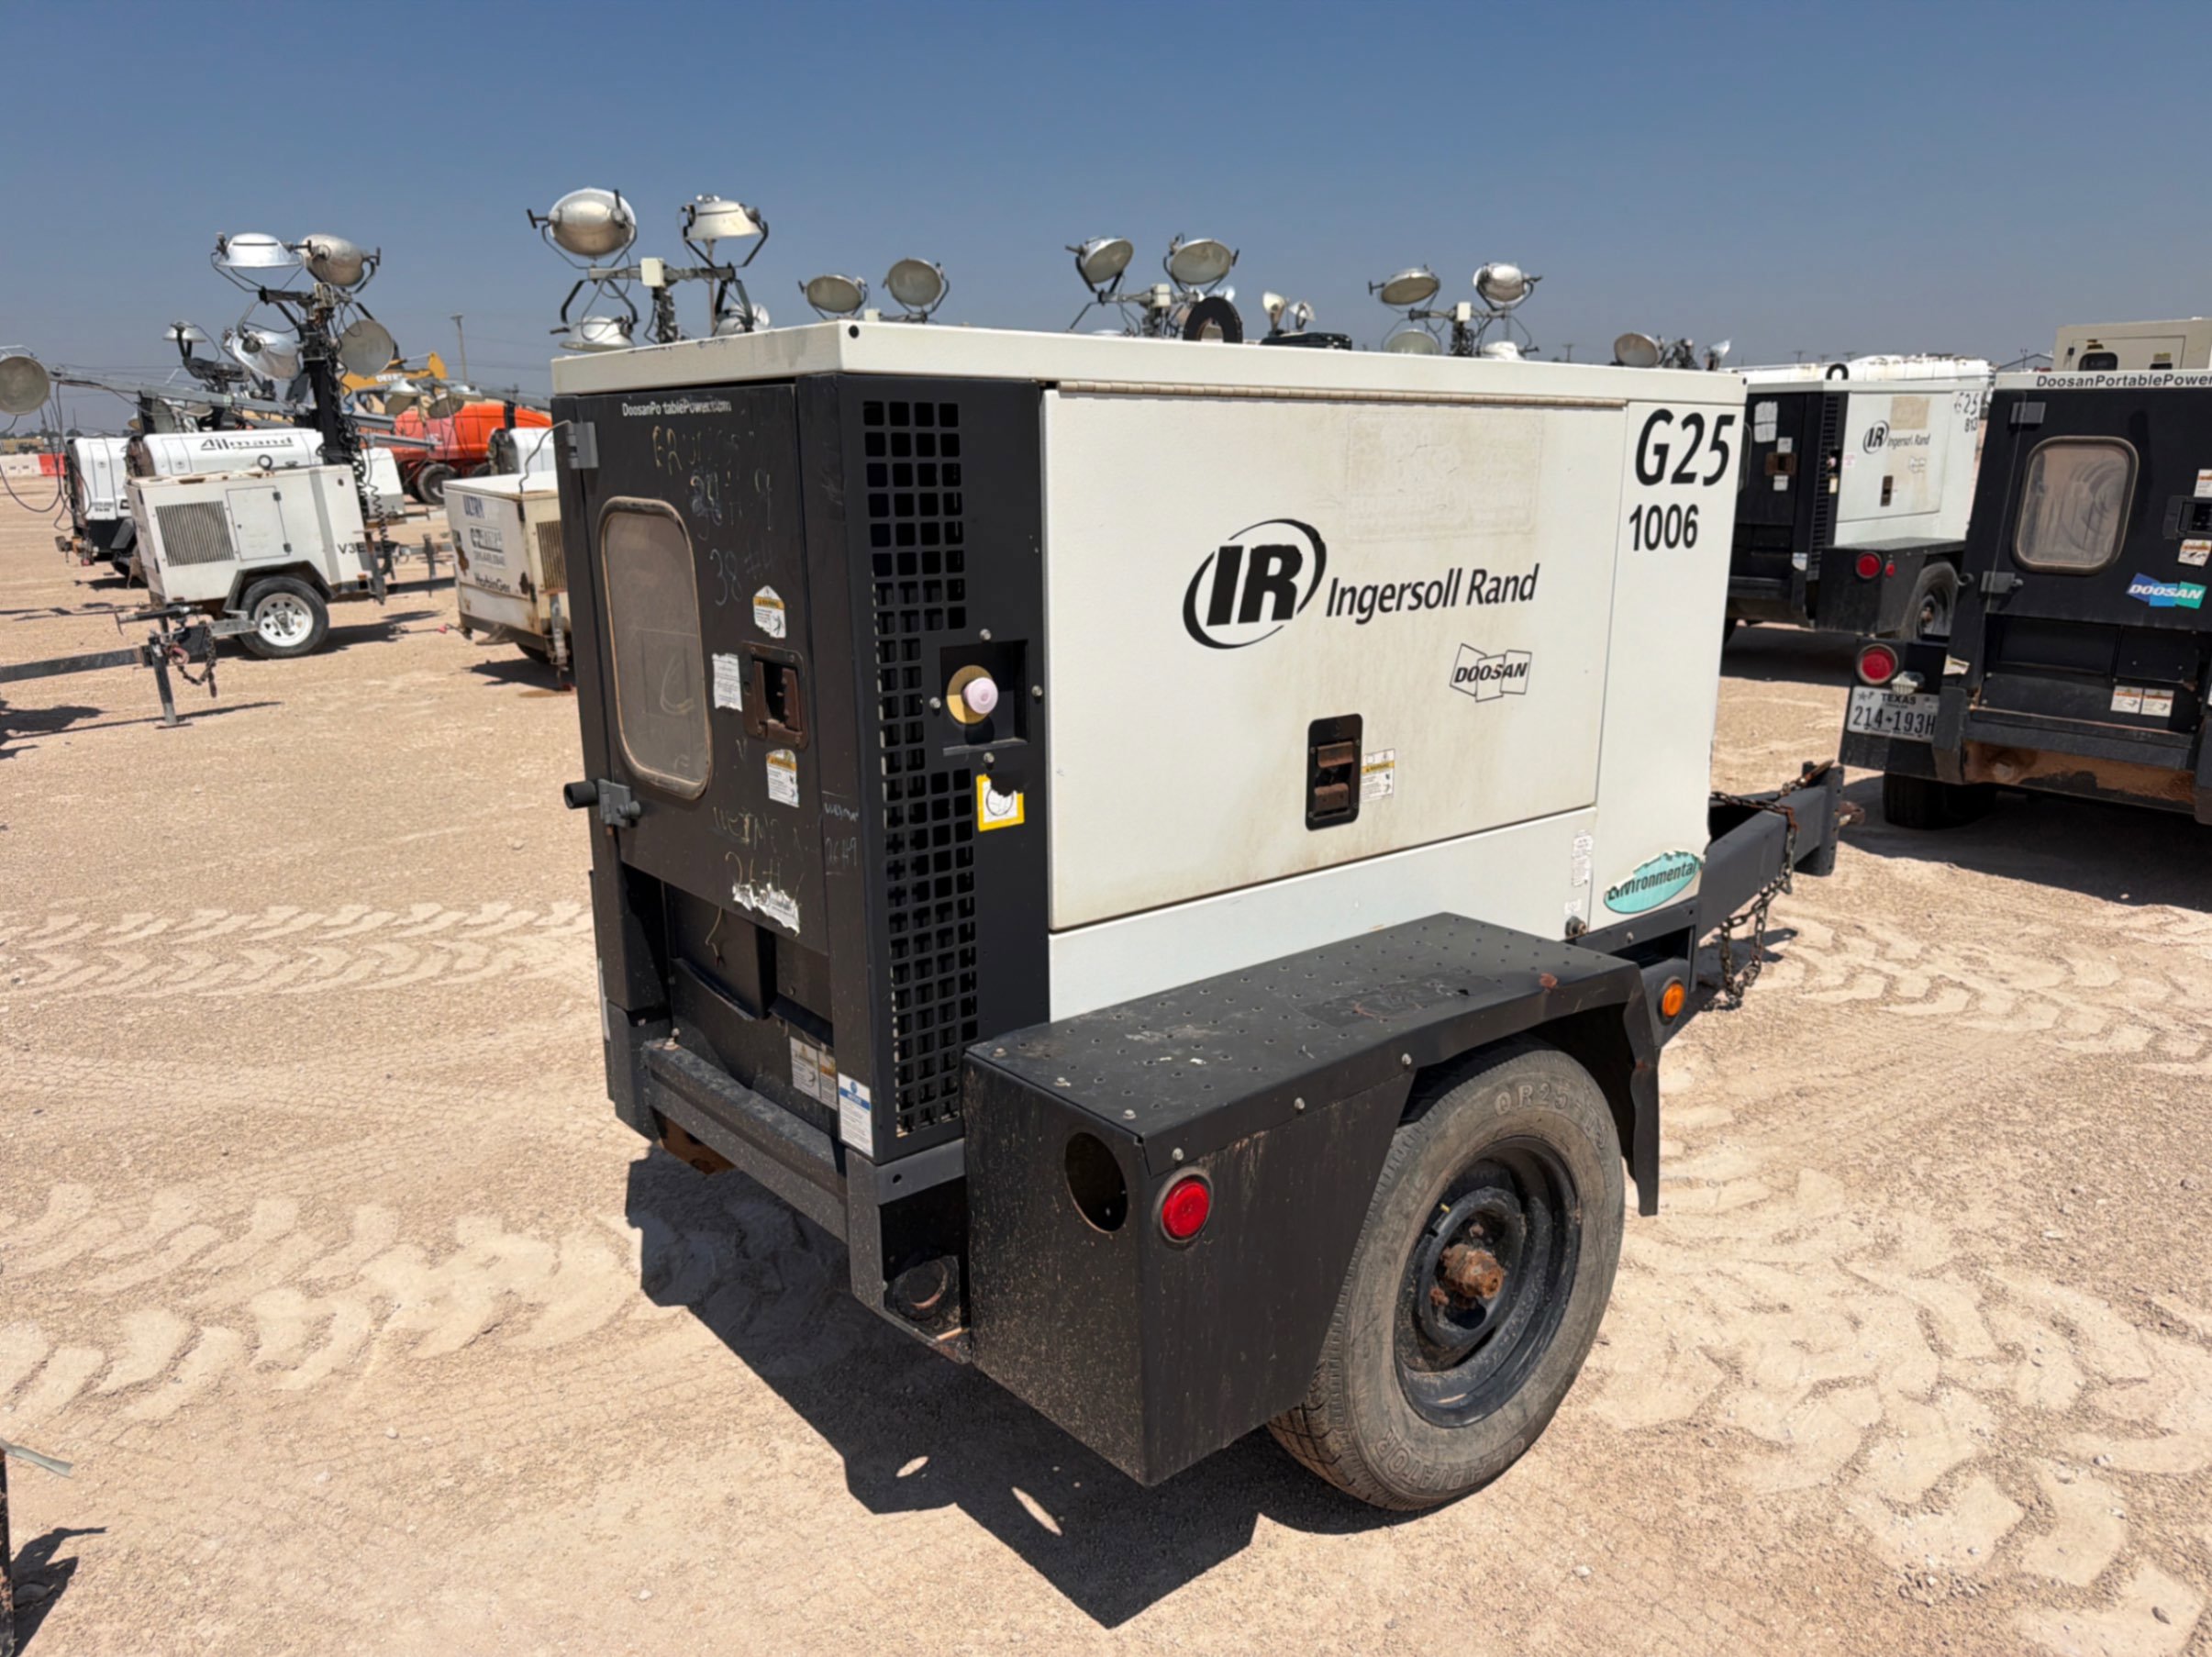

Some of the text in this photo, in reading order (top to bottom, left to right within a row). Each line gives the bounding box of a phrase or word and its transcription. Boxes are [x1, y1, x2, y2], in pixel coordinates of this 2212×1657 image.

[201, 436, 294, 450] Allmand
[1635, 408, 1736, 486] G25
[1629, 504, 1699, 551] 1006
[1206, 544, 1540, 627] IR Ingersoll Rand
[2129, 584, 2203, 599] DOOSAN
[1454, 662, 1528, 683] DOOSAN
[1881, 693, 1917, 705] TEXAS
